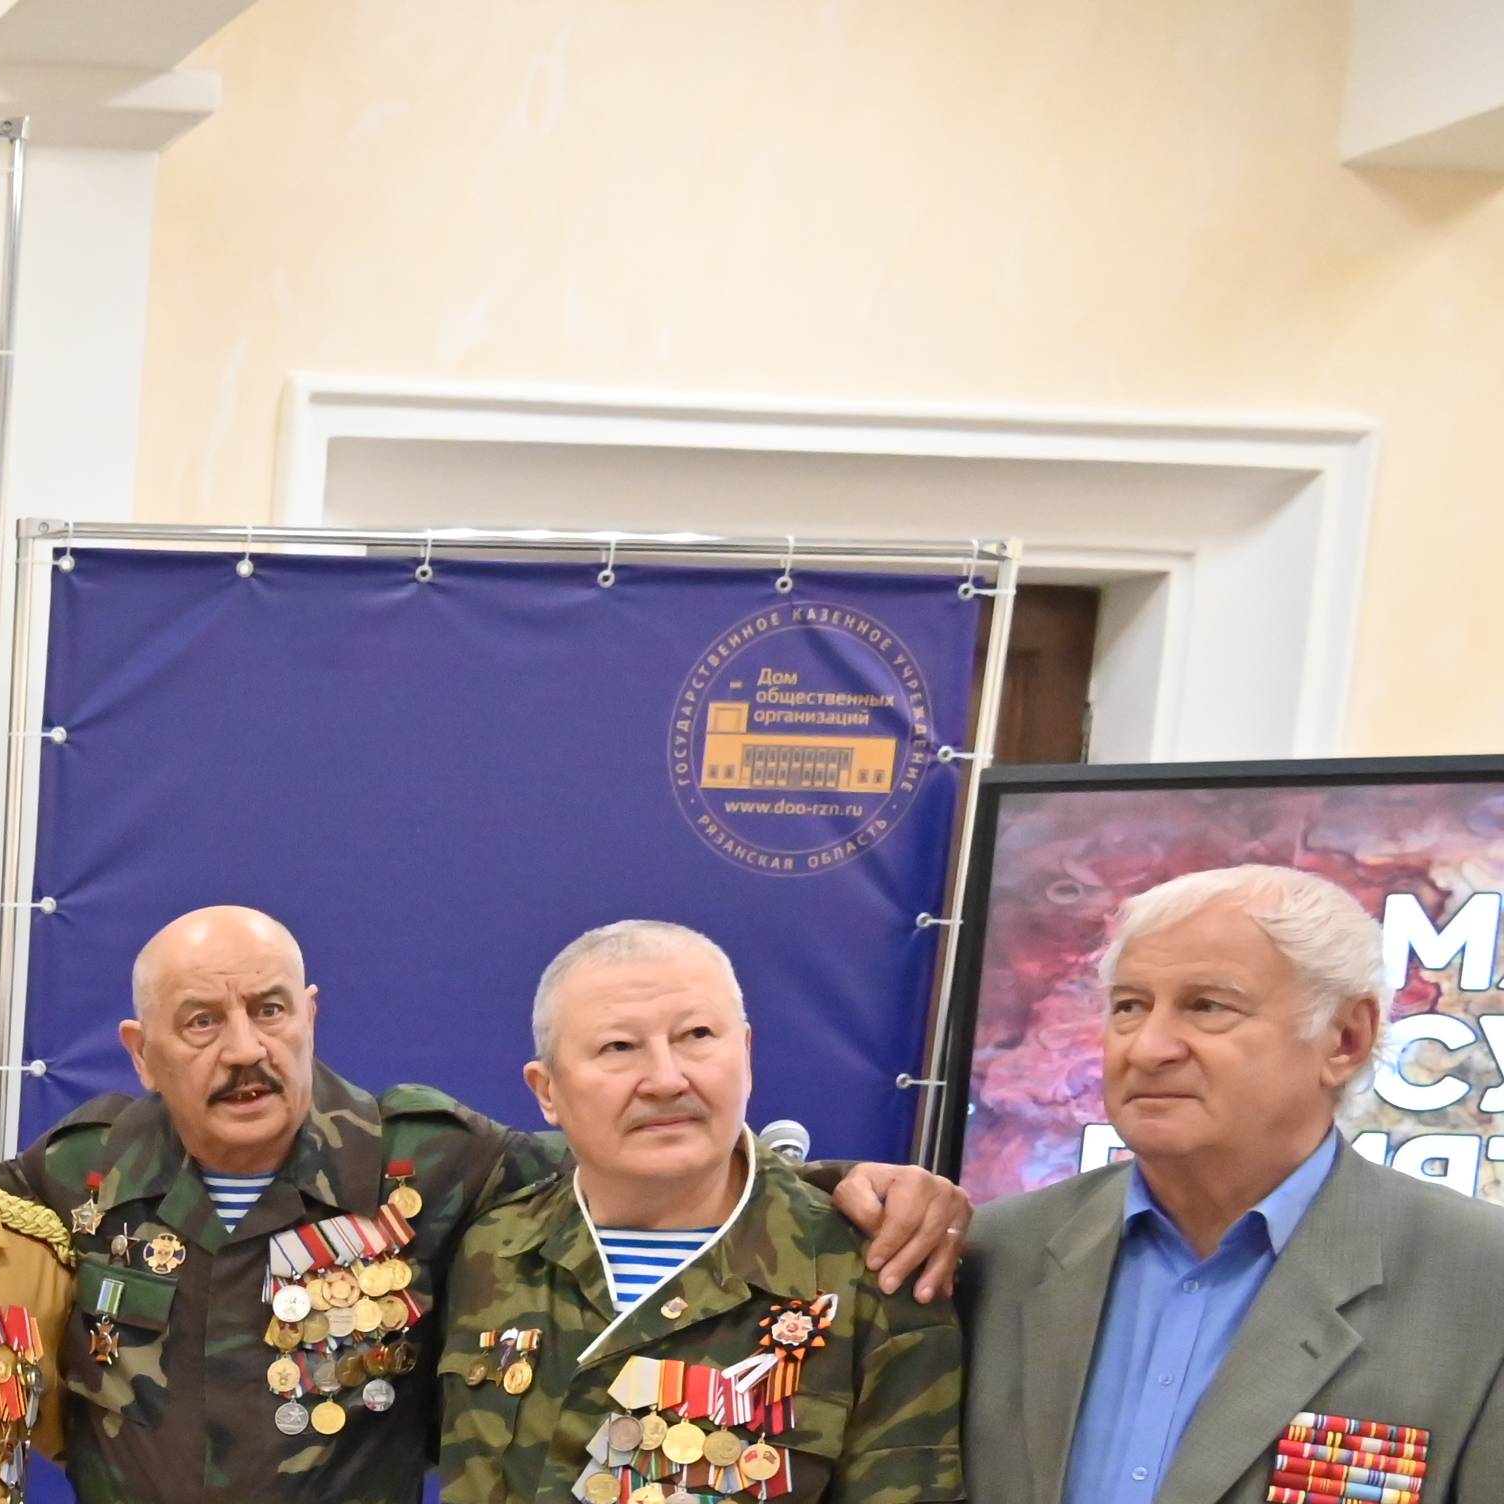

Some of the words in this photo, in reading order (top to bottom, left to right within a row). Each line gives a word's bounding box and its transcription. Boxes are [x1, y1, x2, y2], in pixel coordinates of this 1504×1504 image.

[757, 667, 798, 686] Дом
[674, 611, 781, 787] ГОСУДАРСТВЕННОЕ
[792, 607, 892, 651] КАЗЕННОЕ
[892, 653, 931, 792] УЧРЕЖДЕНИЕ
[755, 686, 895, 707] общественных
[753, 709, 870, 726] организаций
[724, 798, 863, 817] www.doo-rzn.ru
[697, 814, 794, 870] РЯЗАНСКАЯ
[807, 818, 888, 869] ОБЛАСТЬ
